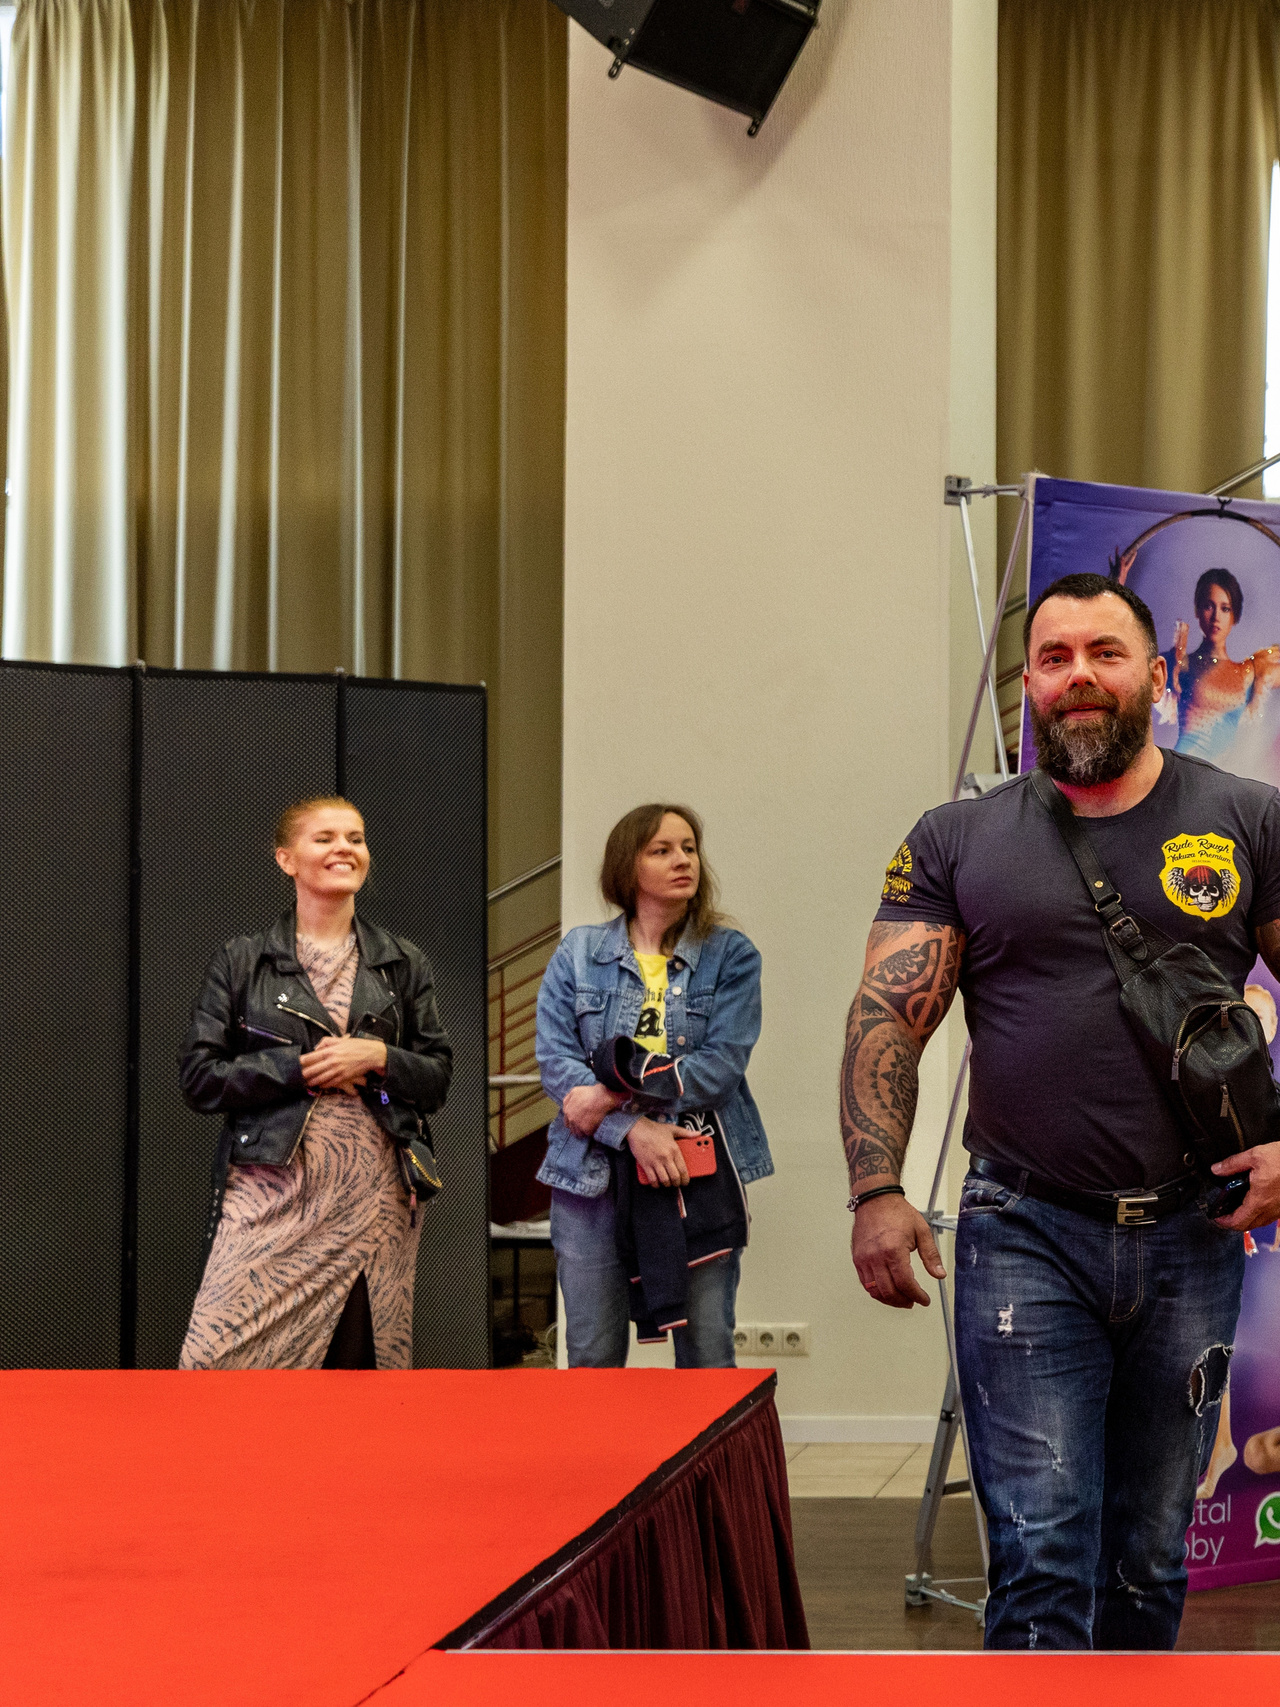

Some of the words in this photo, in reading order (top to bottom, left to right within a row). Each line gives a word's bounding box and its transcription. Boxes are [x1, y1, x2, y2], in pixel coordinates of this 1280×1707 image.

[1164, 839, 1194, 853] Rude
[1196, 838, 1230, 854] Rough
[1167, 852, 1196, 863] Yakuza
[1197, 849, 1232, 864] Premium
